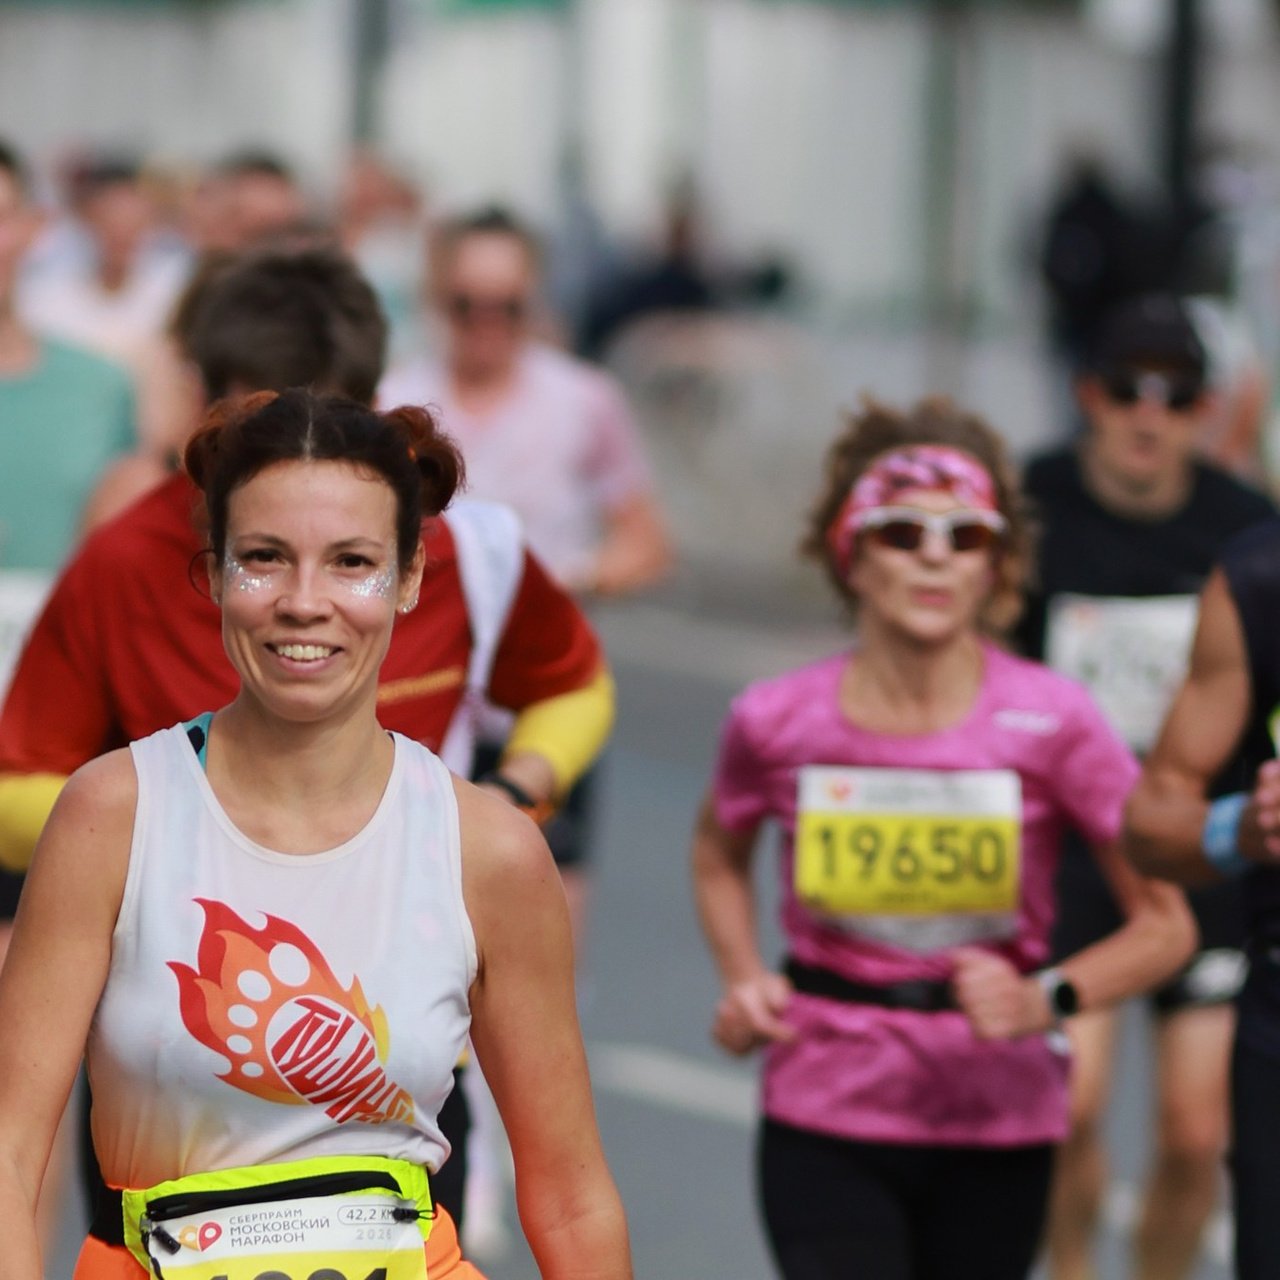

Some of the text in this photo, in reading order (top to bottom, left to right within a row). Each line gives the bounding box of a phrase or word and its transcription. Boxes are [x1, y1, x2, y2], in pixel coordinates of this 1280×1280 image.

[815, 824, 1006, 885] 19650
[229, 1209, 303, 1225] СБЕРПРАЙМ
[346, 1208, 377, 1222] 42,2
[230, 1217, 330, 1236] МОСКОВСКИЙ
[231, 1232, 305, 1247] МАРАФОН
